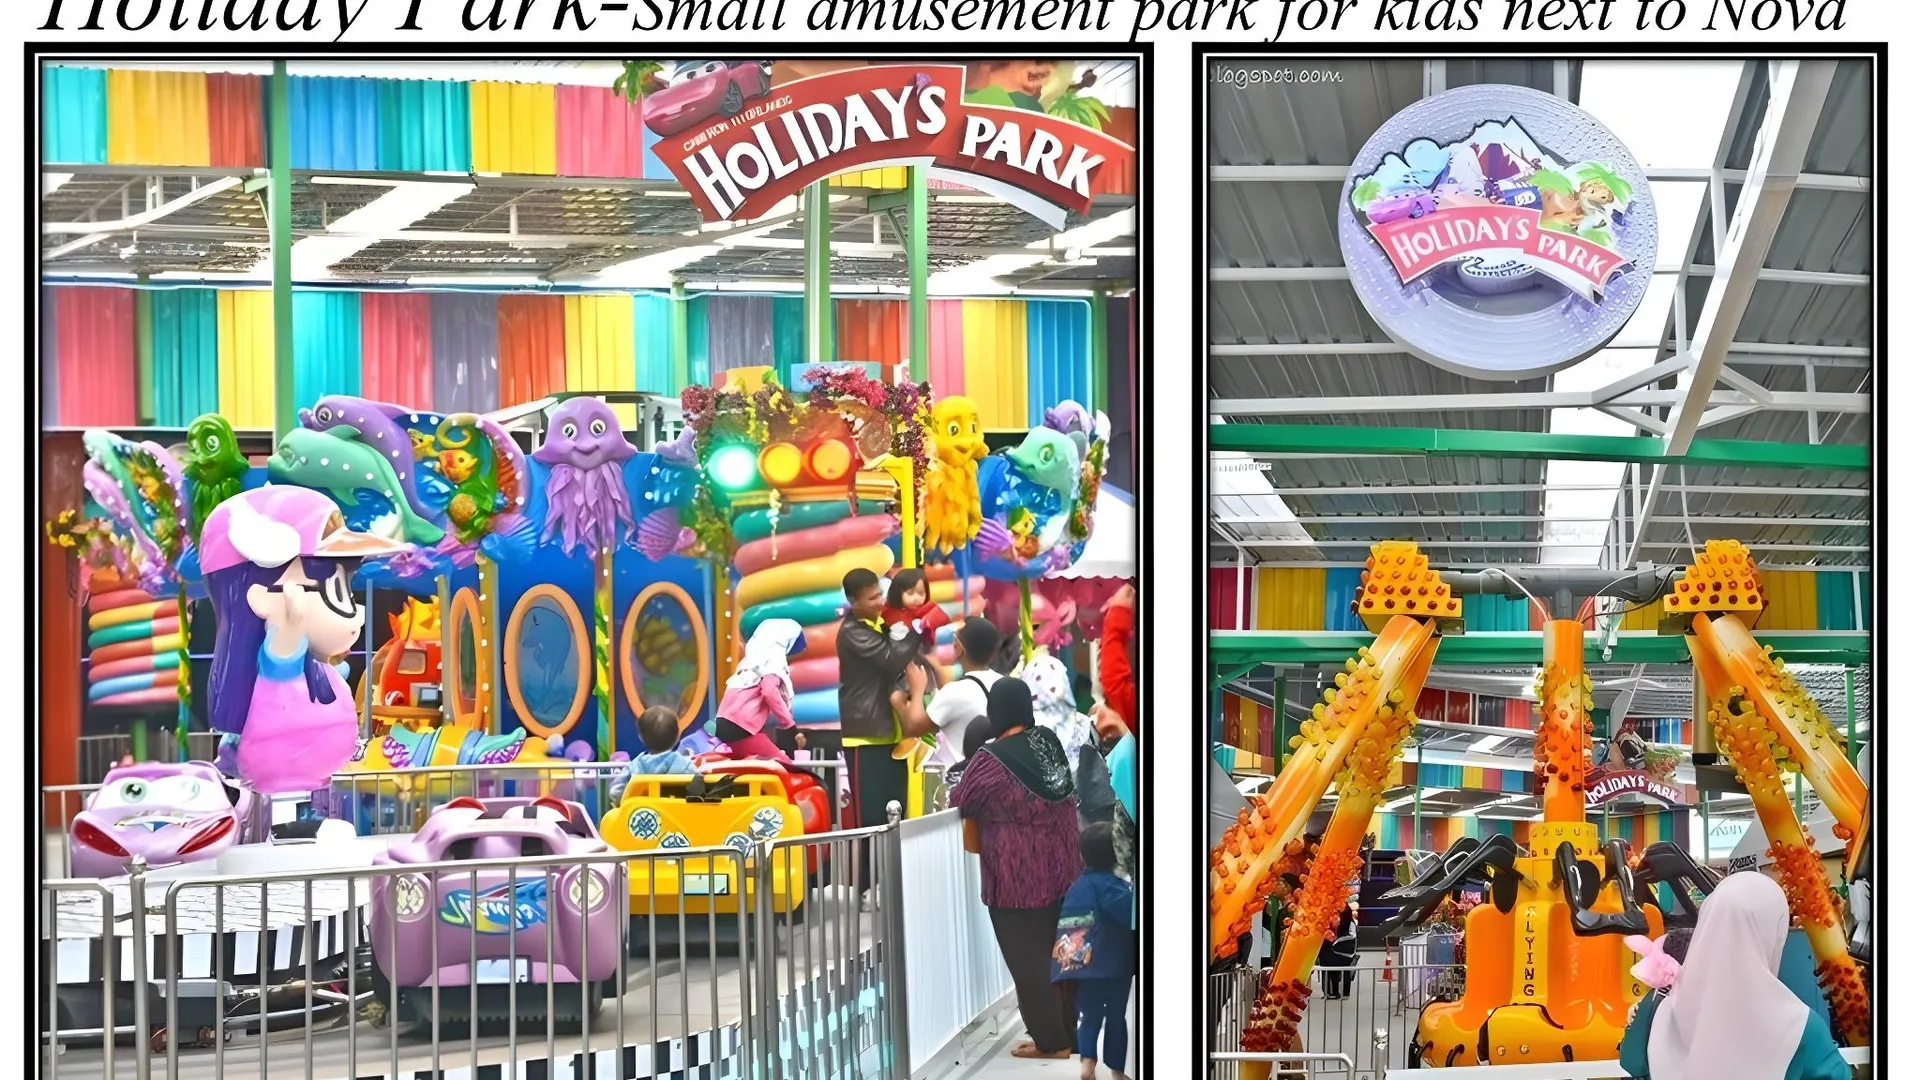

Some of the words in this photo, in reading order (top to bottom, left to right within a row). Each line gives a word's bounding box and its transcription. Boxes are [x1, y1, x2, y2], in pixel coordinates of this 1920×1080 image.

[959, 115, 1106, 199] PARK
[1537, 235, 1608, 278] PARK
[1647, 781, 1679, 801] PARK
